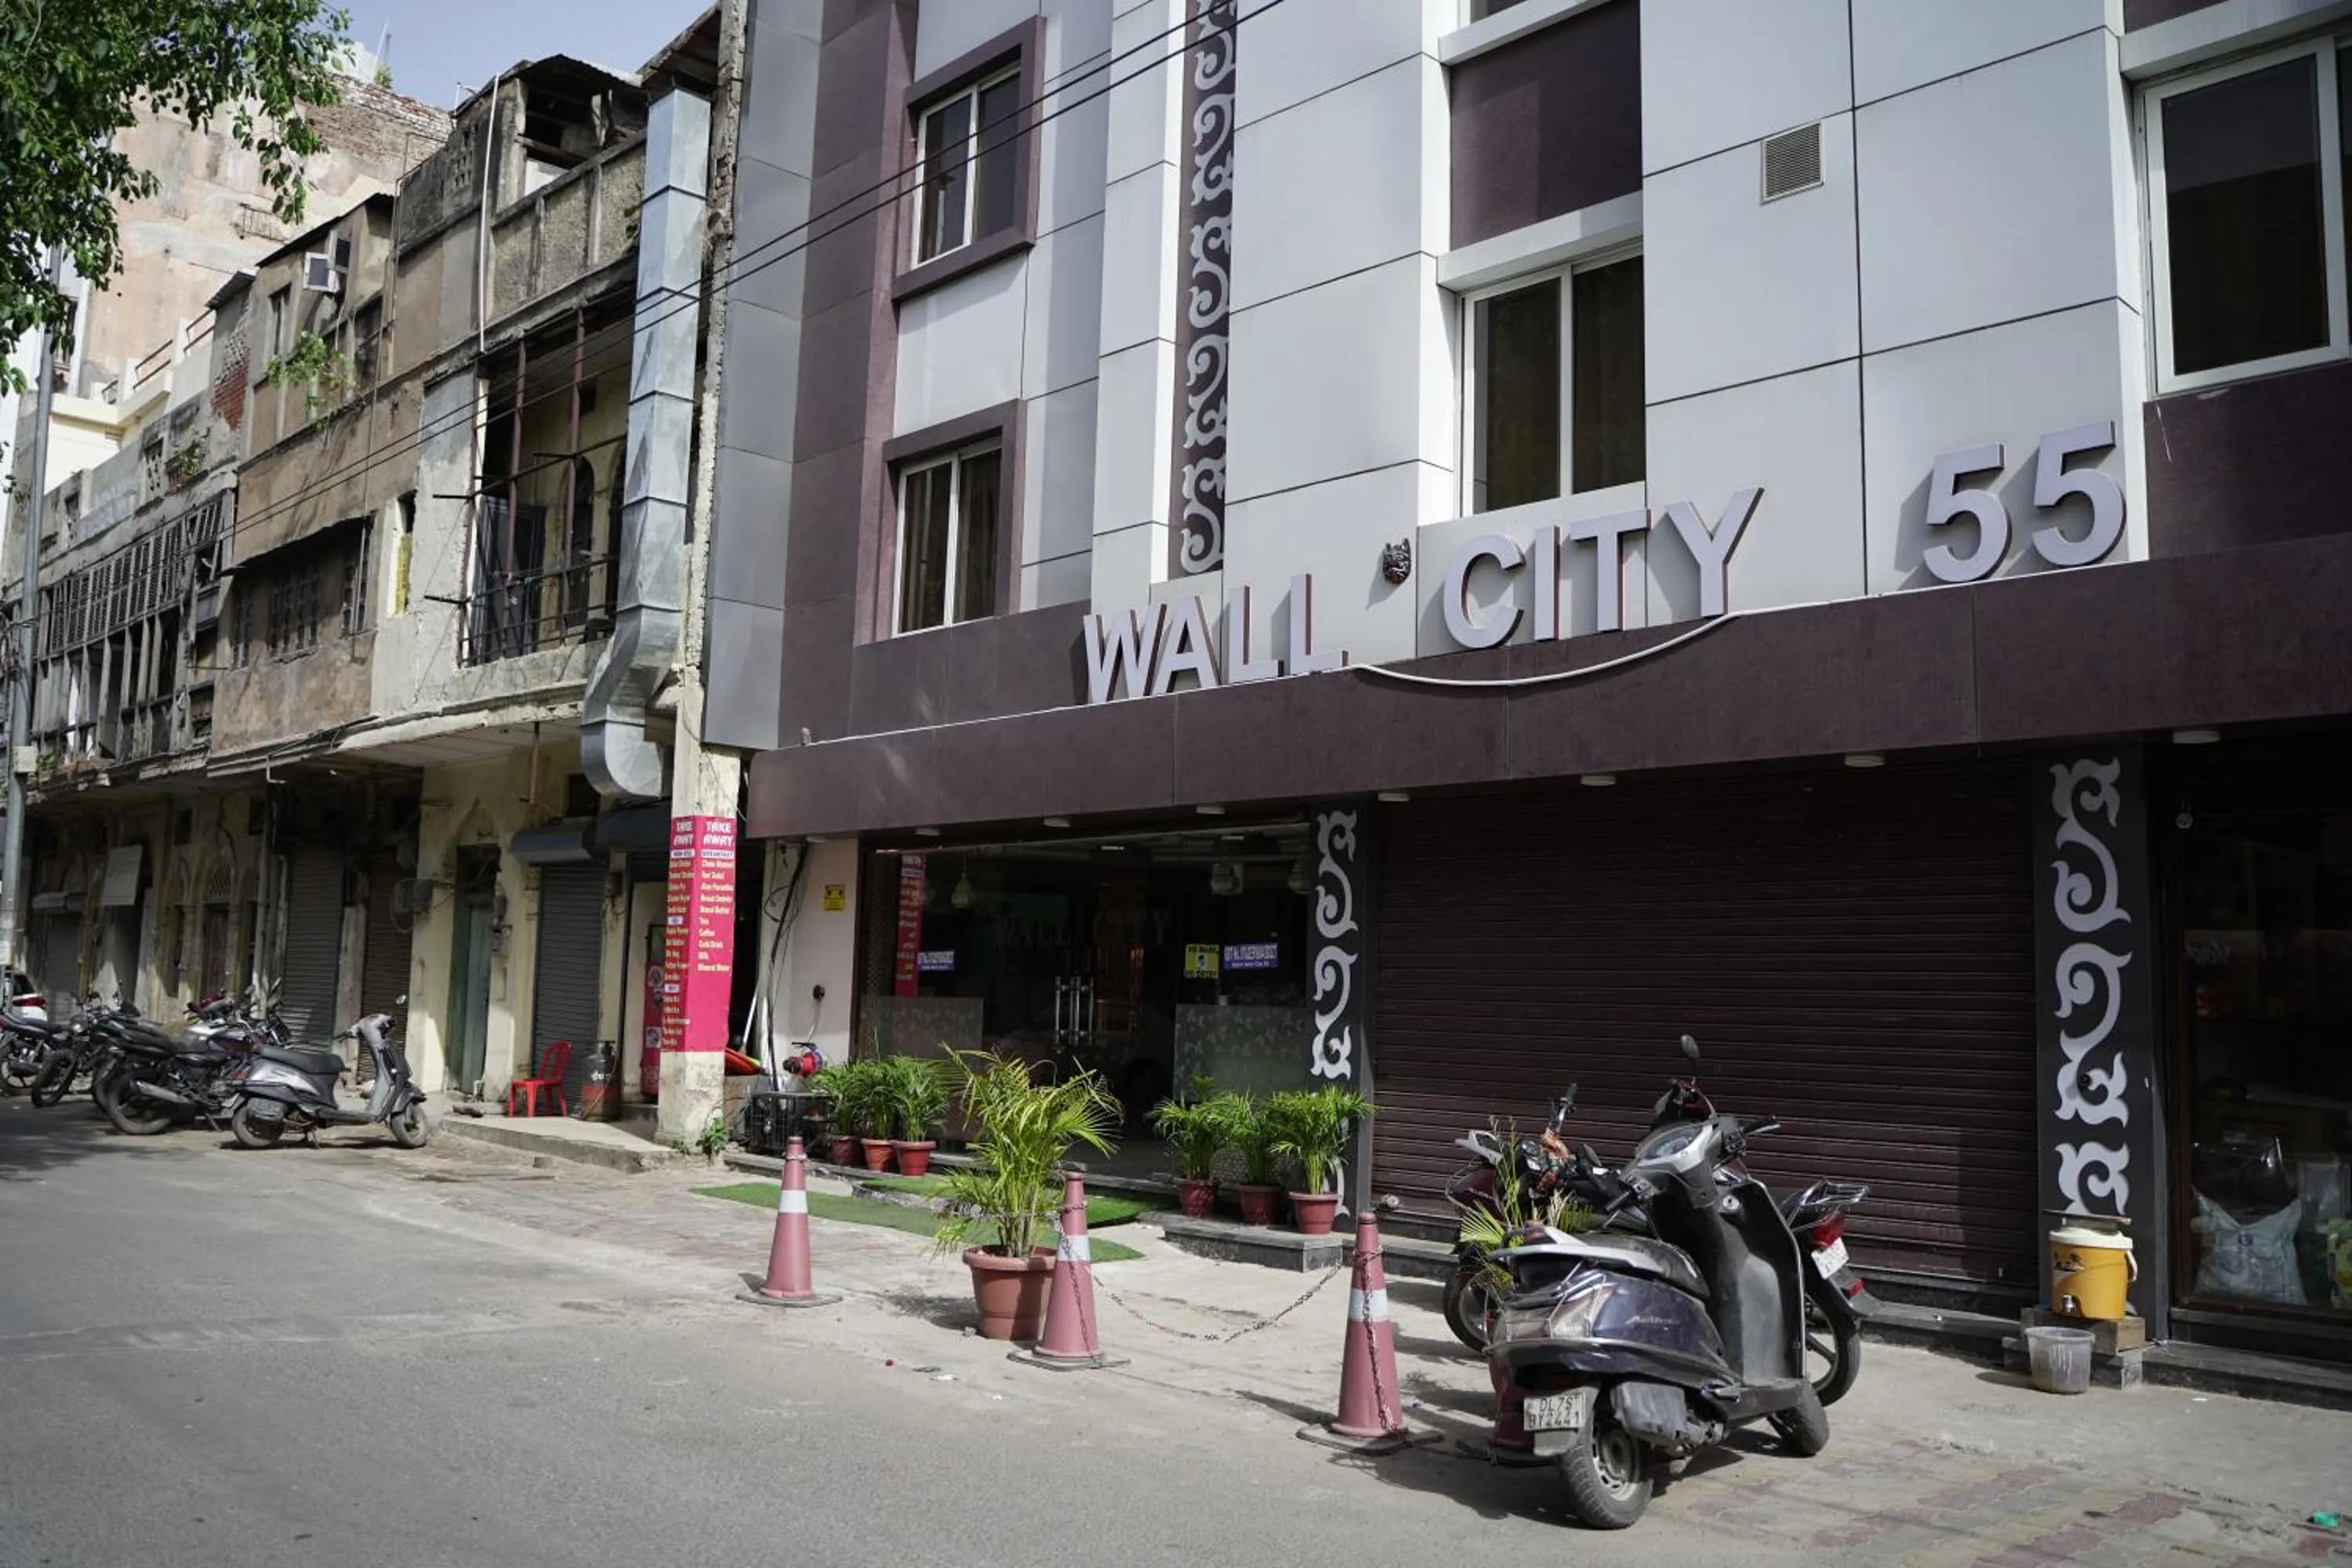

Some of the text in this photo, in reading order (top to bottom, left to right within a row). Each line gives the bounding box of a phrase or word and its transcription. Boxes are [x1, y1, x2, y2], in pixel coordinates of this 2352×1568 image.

[1083, 419, 2127, 704] WALL CITY 55
[706, 821, 731, 833] TAKE
[703, 834, 733, 847] AWAY
[699, 928, 715, 937] Coffee
